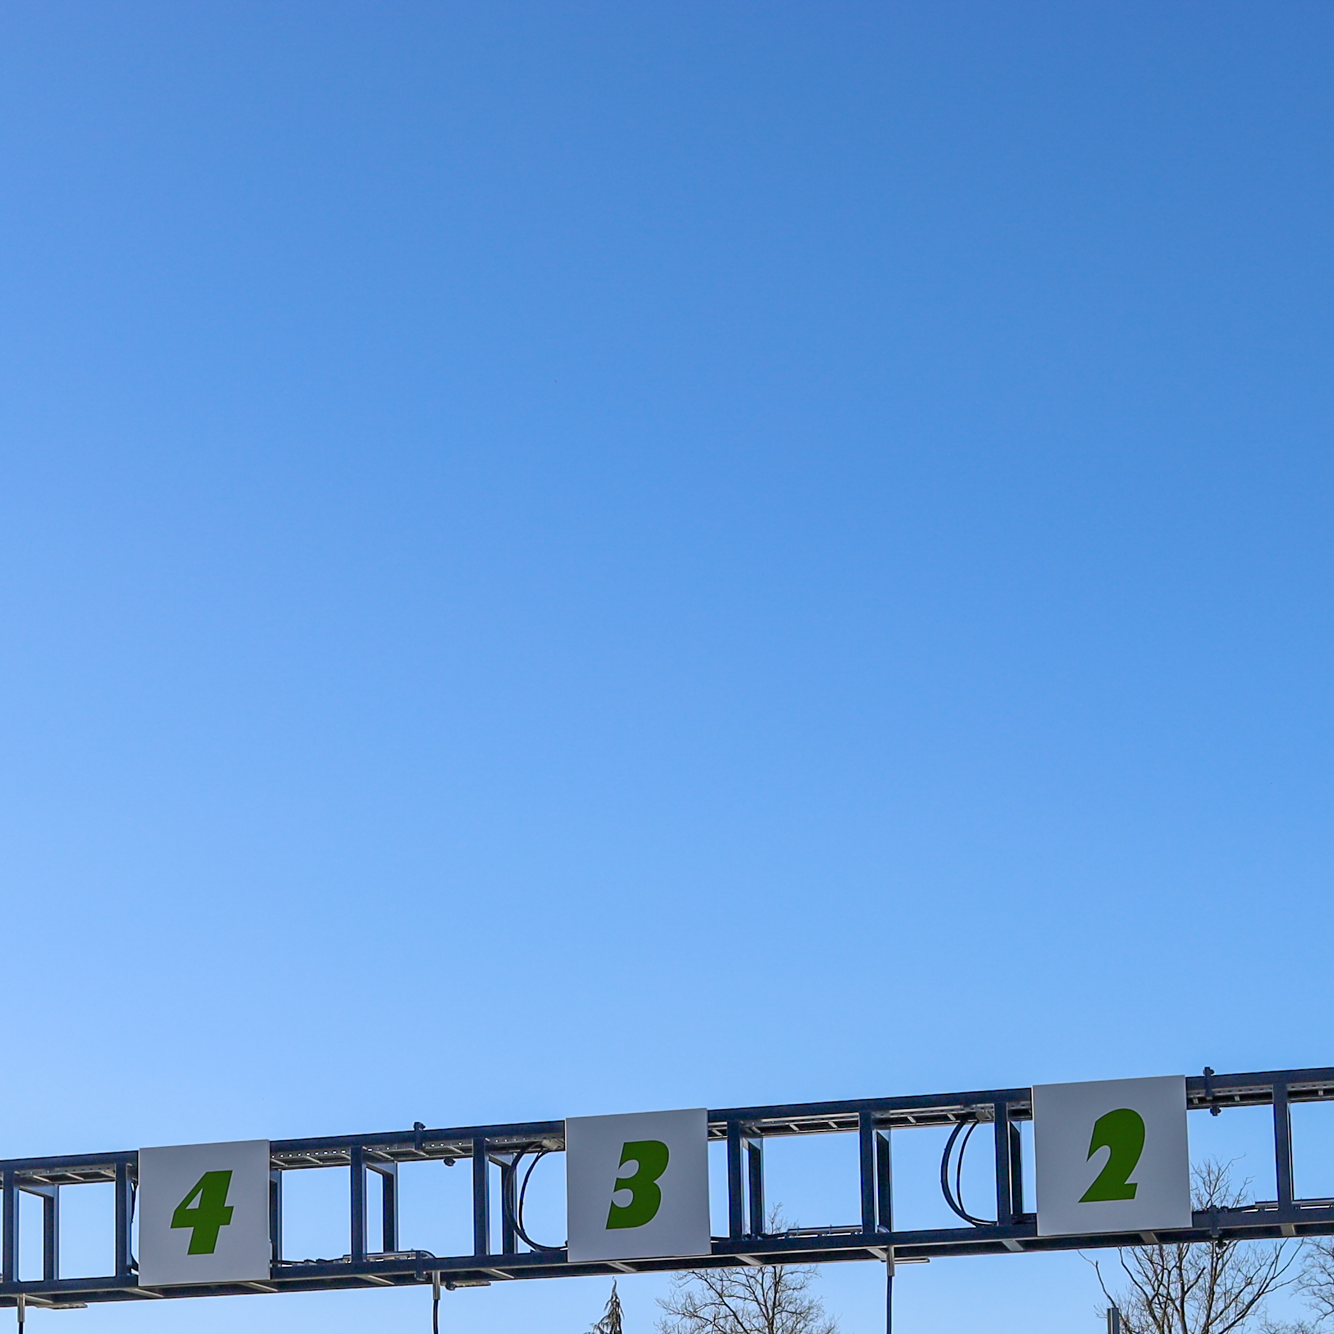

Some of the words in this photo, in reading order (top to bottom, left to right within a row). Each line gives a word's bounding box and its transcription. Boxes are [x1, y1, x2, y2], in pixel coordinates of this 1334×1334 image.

[606, 1140, 670, 1230] 3
[1080, 1108, 1146, 1203] 2
[170, 1169, 234, 1256] 4
